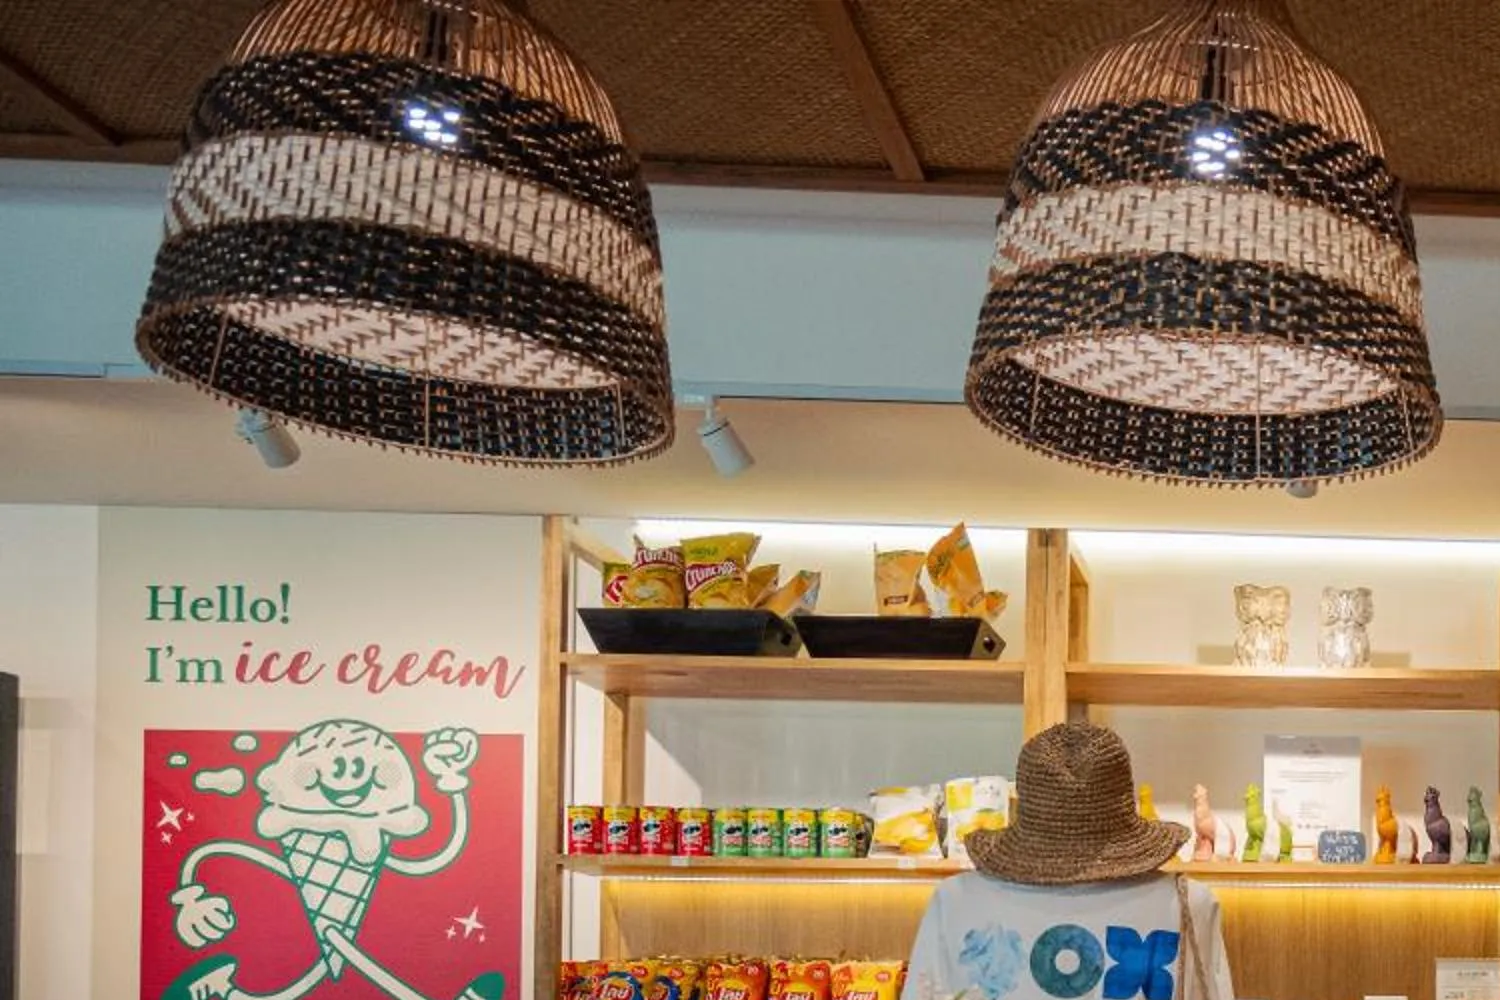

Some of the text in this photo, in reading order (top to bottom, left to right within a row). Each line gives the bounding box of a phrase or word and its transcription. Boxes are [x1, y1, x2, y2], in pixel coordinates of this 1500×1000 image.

[145, 583, 290, 624] Hello!
[235, 641, 326, 685] ice
[337, 644, 526, 699] cream
